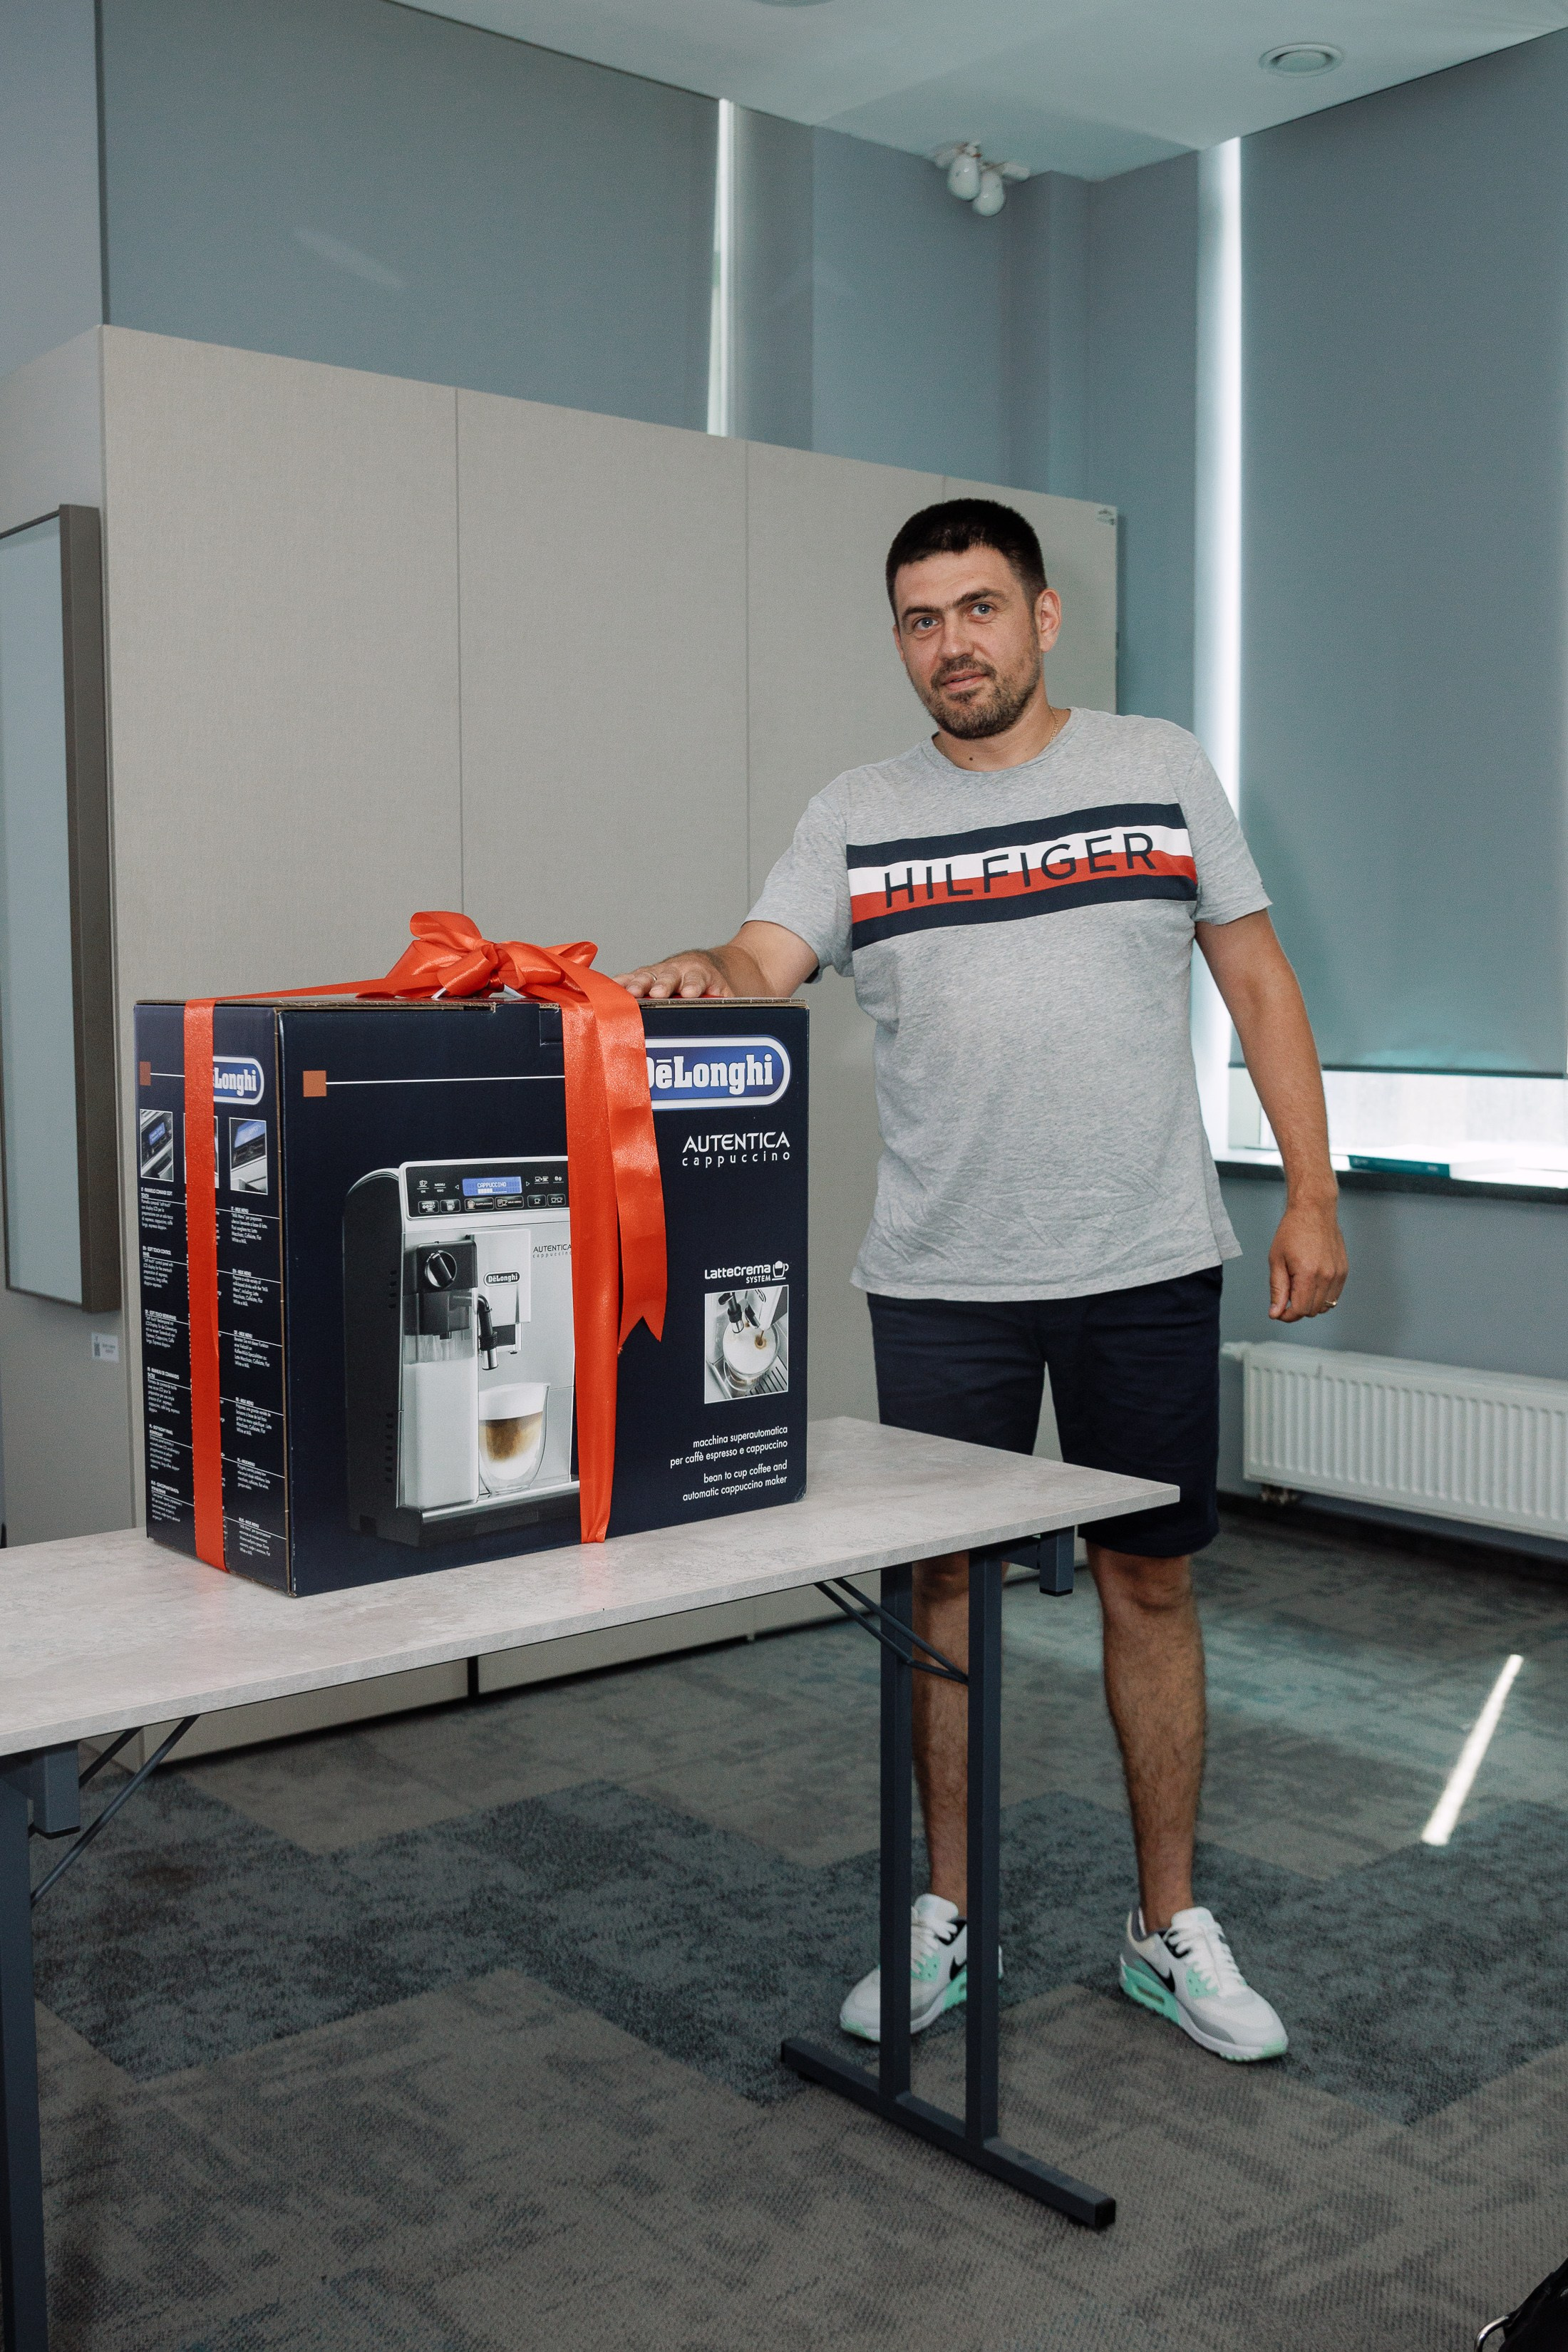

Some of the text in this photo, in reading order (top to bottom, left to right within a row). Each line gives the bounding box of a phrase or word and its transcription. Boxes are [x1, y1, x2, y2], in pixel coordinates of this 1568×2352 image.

[884, 832, 1157, 909] HILFIGER
[212, 1067, 257, 1097] Longhi
[682, 1130, 790, 1153] AUTENTICA
[682, 1150, 790, 1168] cappuccino
[533, 1244, 572, 1253] AUTENTICA
[704, 1264, 771, 1279] LatteCrema
[746, 1274, 771, 1284] SYSTEM
[693, 1425, 788, 1448] macchina superautomatica
[670, 1457, 684, 1469] per
[685, 1451, 704, 1463] caffè
[706, 1448, 737, 1461] espresso
[746, 1440, 788, 1455] cappuccino
[703, 1459, 788, 1483] bean to cup coffee and
[682, 1474, 788, 1501] automatic cappuccino maker
